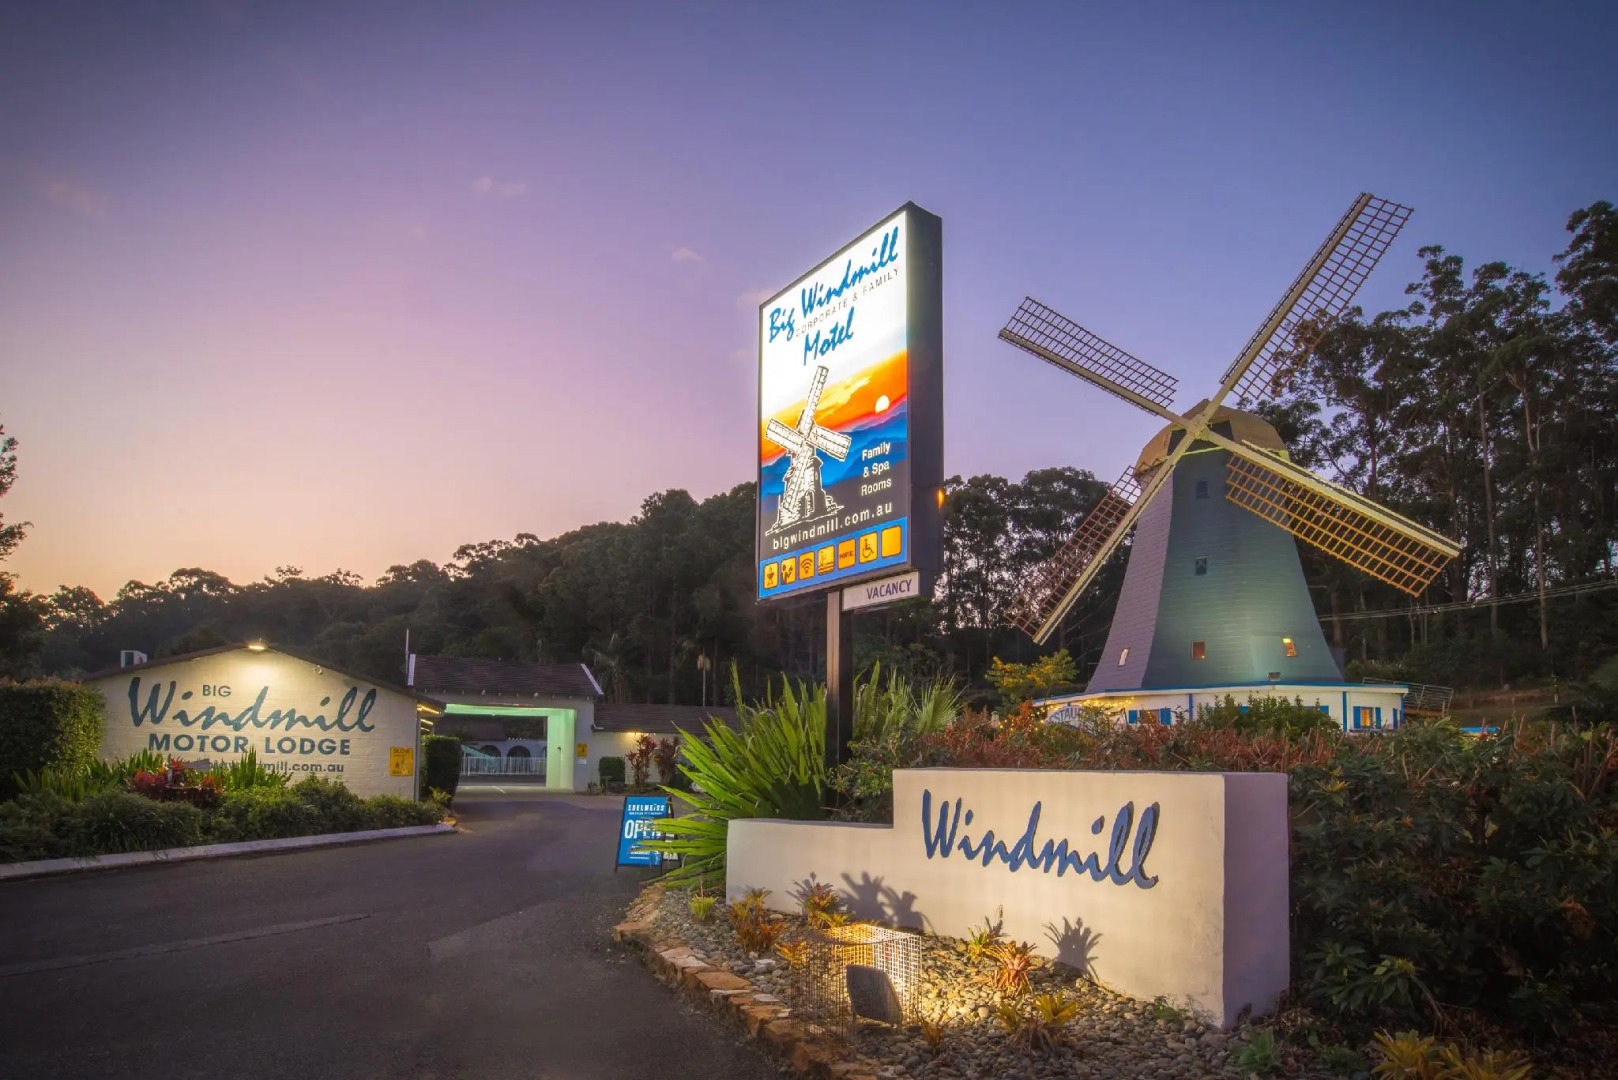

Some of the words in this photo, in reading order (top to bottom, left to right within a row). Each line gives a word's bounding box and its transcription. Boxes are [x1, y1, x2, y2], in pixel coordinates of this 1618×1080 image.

[769, 306, 796, 343] Big
[801, 226, 899, 319] Windmill
[796, 298, 848, 337] CORPORATE
[852, 292, 859, 302] &
[862, 266, 900, 296] FAMILY
[803, 306, 855, 366] Motel
[861, 441, 891, 461] Family
[863, 467, 869, 478] &
[871, 461, 890, 476] Spa
[861, 479, 892, 497] Rooms
[773, 502, 893, 550] bigwindmill.com.au
[866, 579, 912, 600] VACANCY
[128, 676, 377, 732] Windmill
[202, 684, 232, 698] BIG
[149, 733, 248, 754] MOTOR
[265, 736, 350, 756] LODGE
[922, 789, 1160, 890] Windmill
